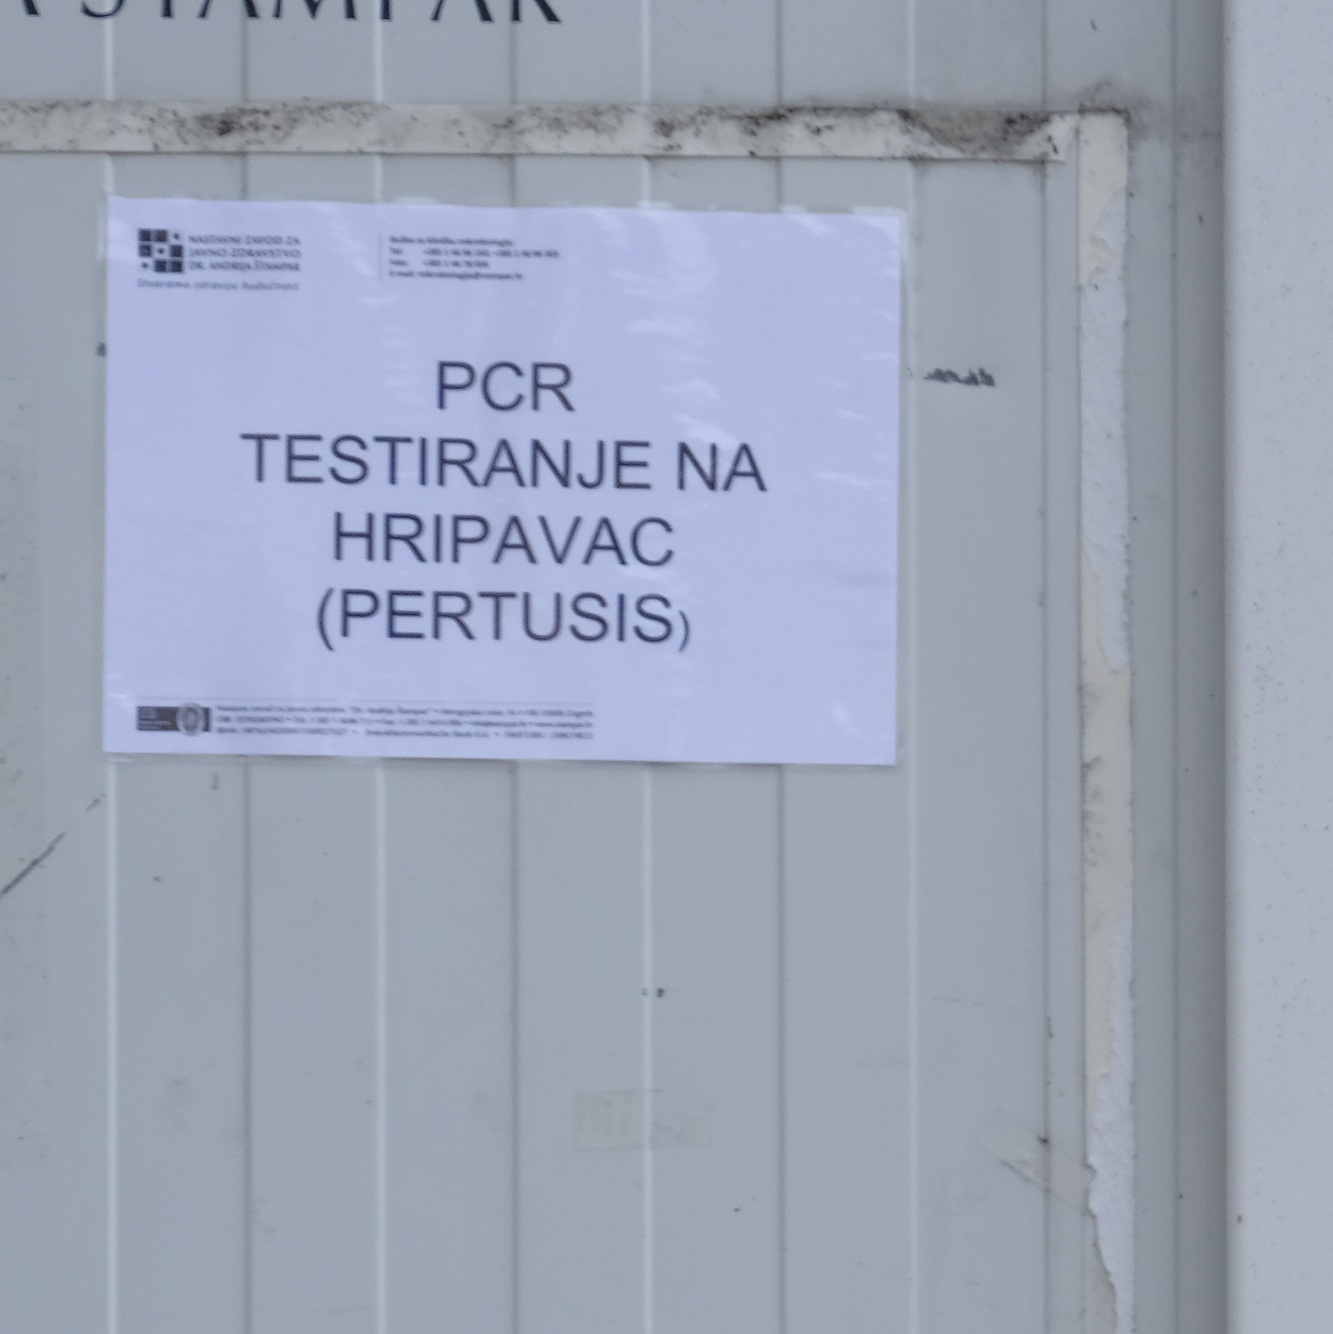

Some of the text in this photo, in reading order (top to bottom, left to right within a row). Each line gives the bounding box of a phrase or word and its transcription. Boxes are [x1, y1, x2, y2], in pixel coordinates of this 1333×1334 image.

[437, 360, 576, 413] PCR
[239, 432, 768, 493] TESTIRANJE NA
[332, 511, 676, 567] HRIPAVAC
[316, 586, 691, 653] (PERTUSIS)
